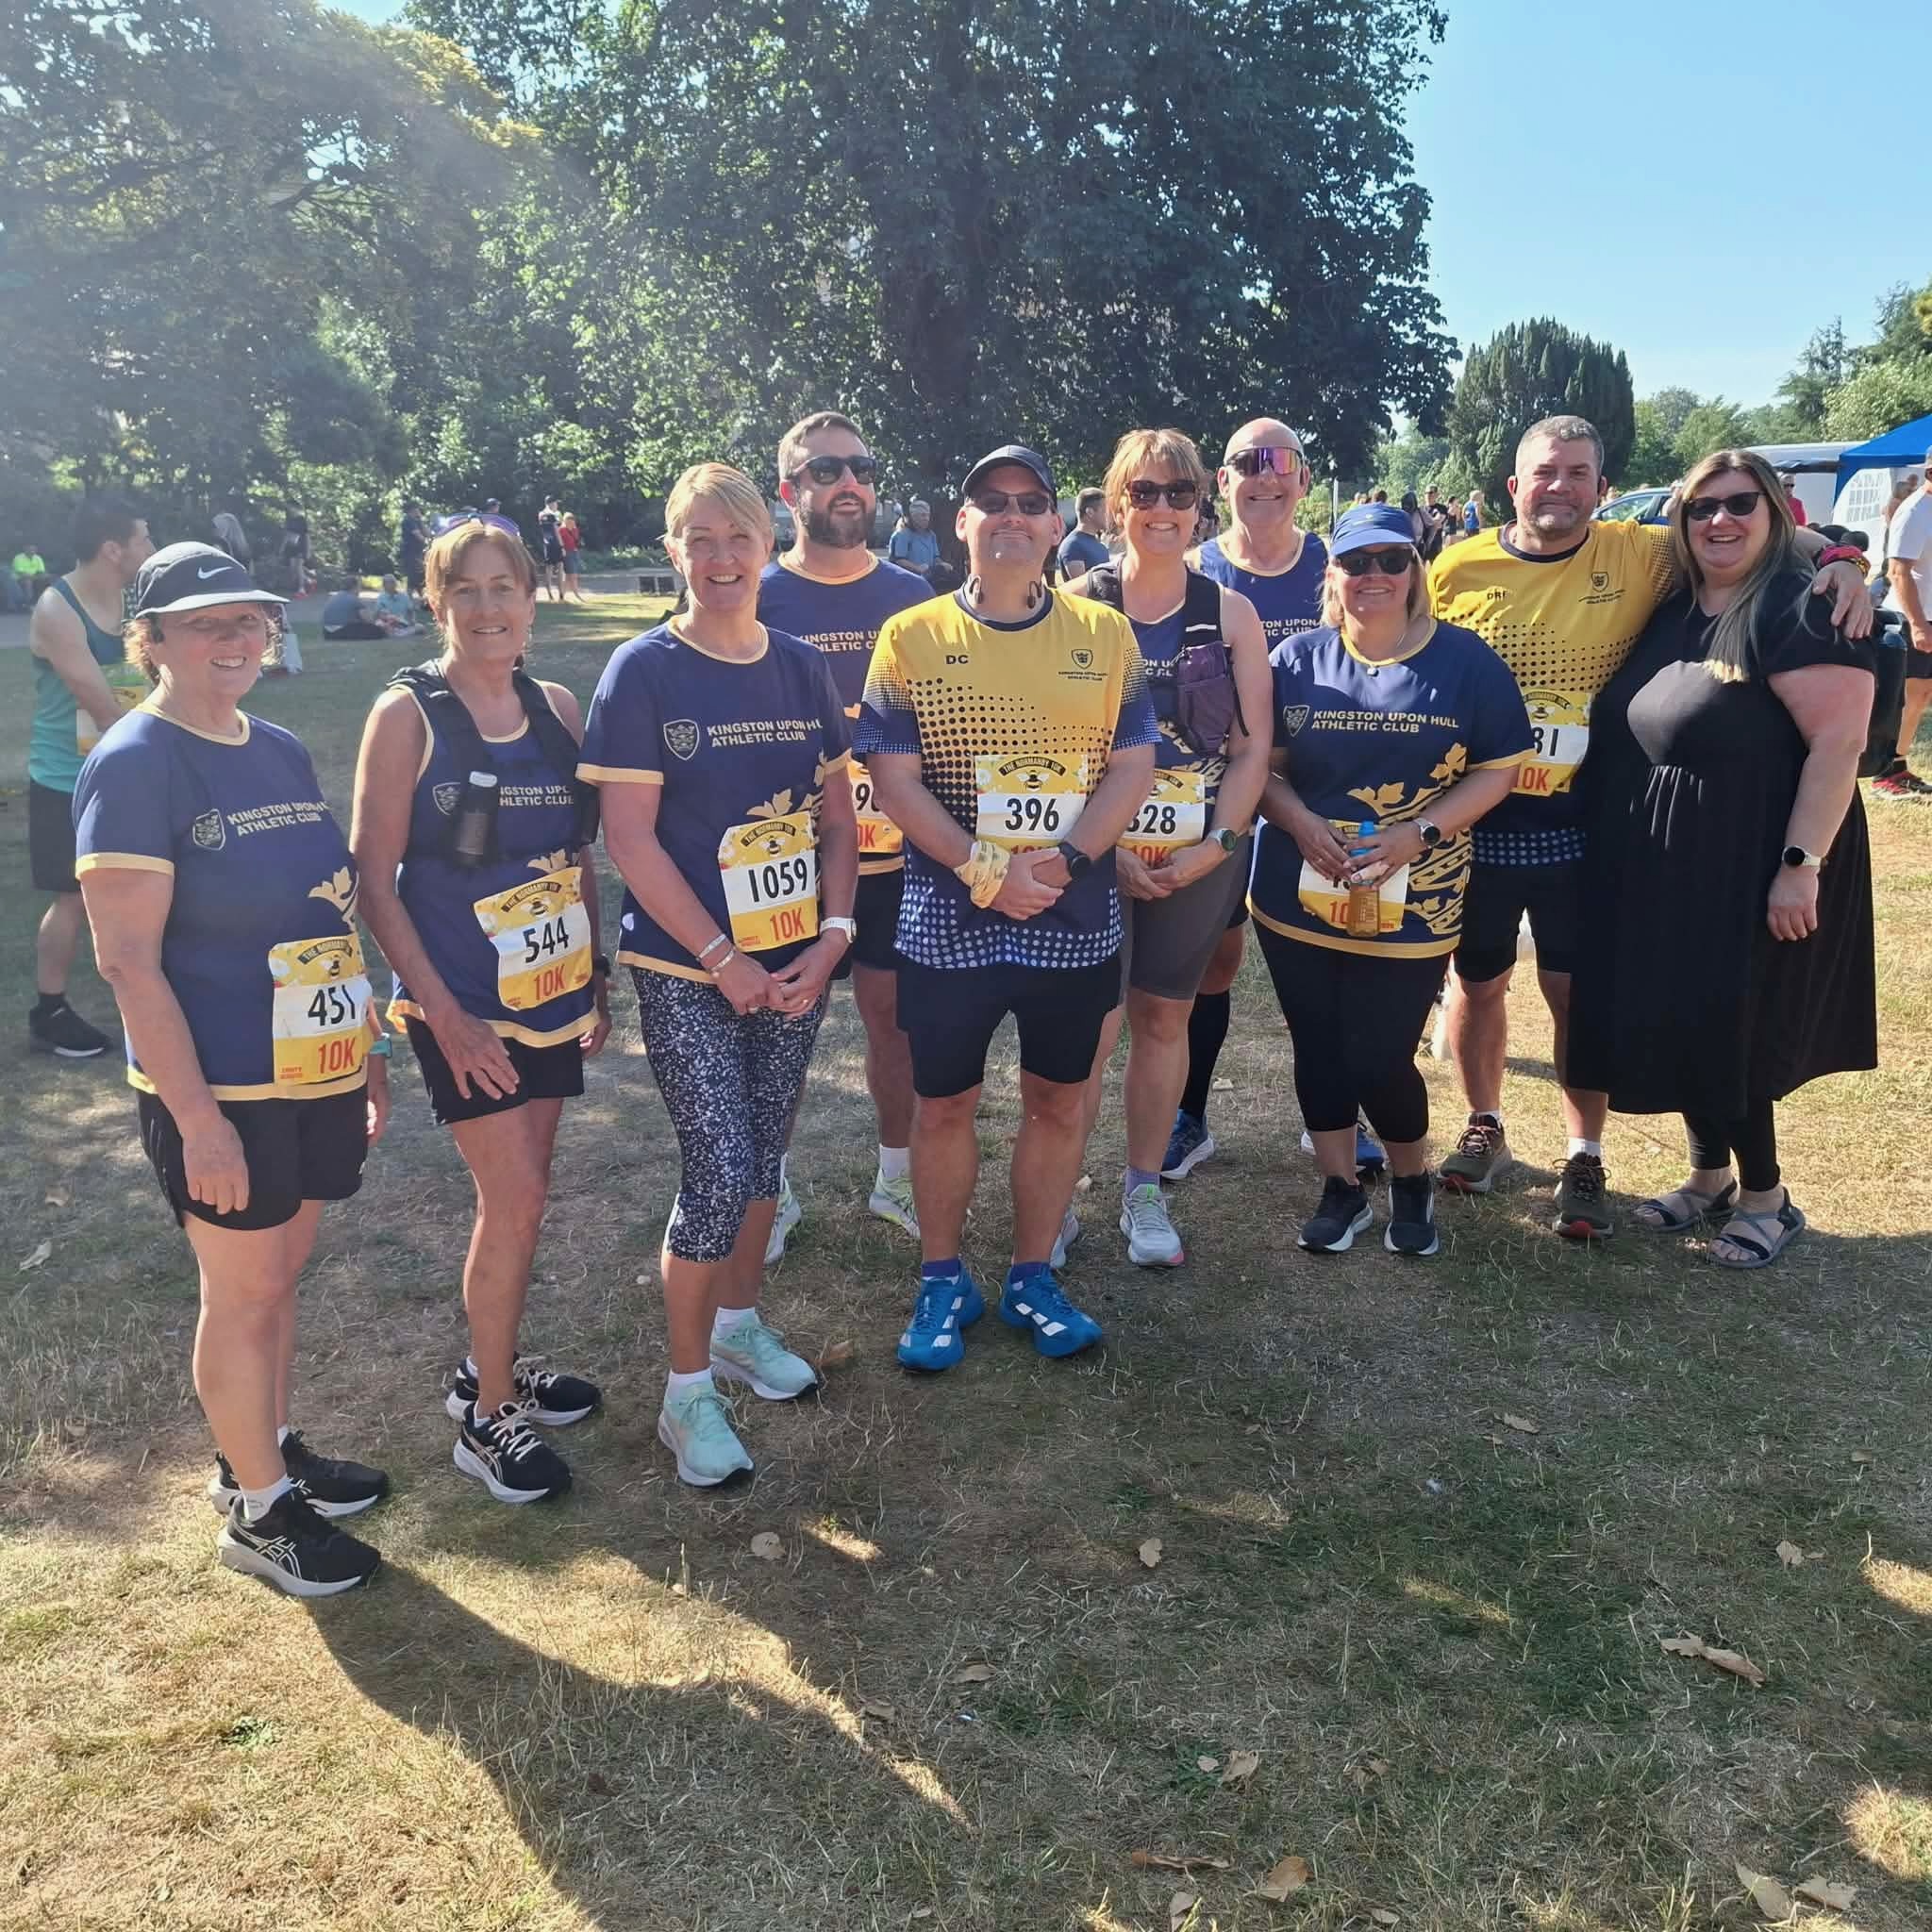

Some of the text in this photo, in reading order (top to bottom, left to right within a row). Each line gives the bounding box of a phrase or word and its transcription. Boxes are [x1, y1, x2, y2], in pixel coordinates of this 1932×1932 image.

[945, 655, 969, 665] DC
[708, 721, 774, 736] KINGSTON
[777, 720, 806, 730] UPON
[1311, 721, 1420, 733] ATHLETIC CLUB
[1313, 710, 1459, 728] KINGSTON UPON HULL
[711, 731, 806, 748] ATHLETIC CLUB
[226, 803, 292, 824] KINGSTON
[237, 812, 297, 837] ATHLETIC
[1005, 798, 1059, 831] 396
[748, 858, 808, 903] 1059
[770, 908, 806, 941] 10K
[523, 916, 569, 963] 544
[533, 963, 566, 1001] 10K
[308, 985, 356, 1026] 451
[318, 1038, 357, 1074] 10K
